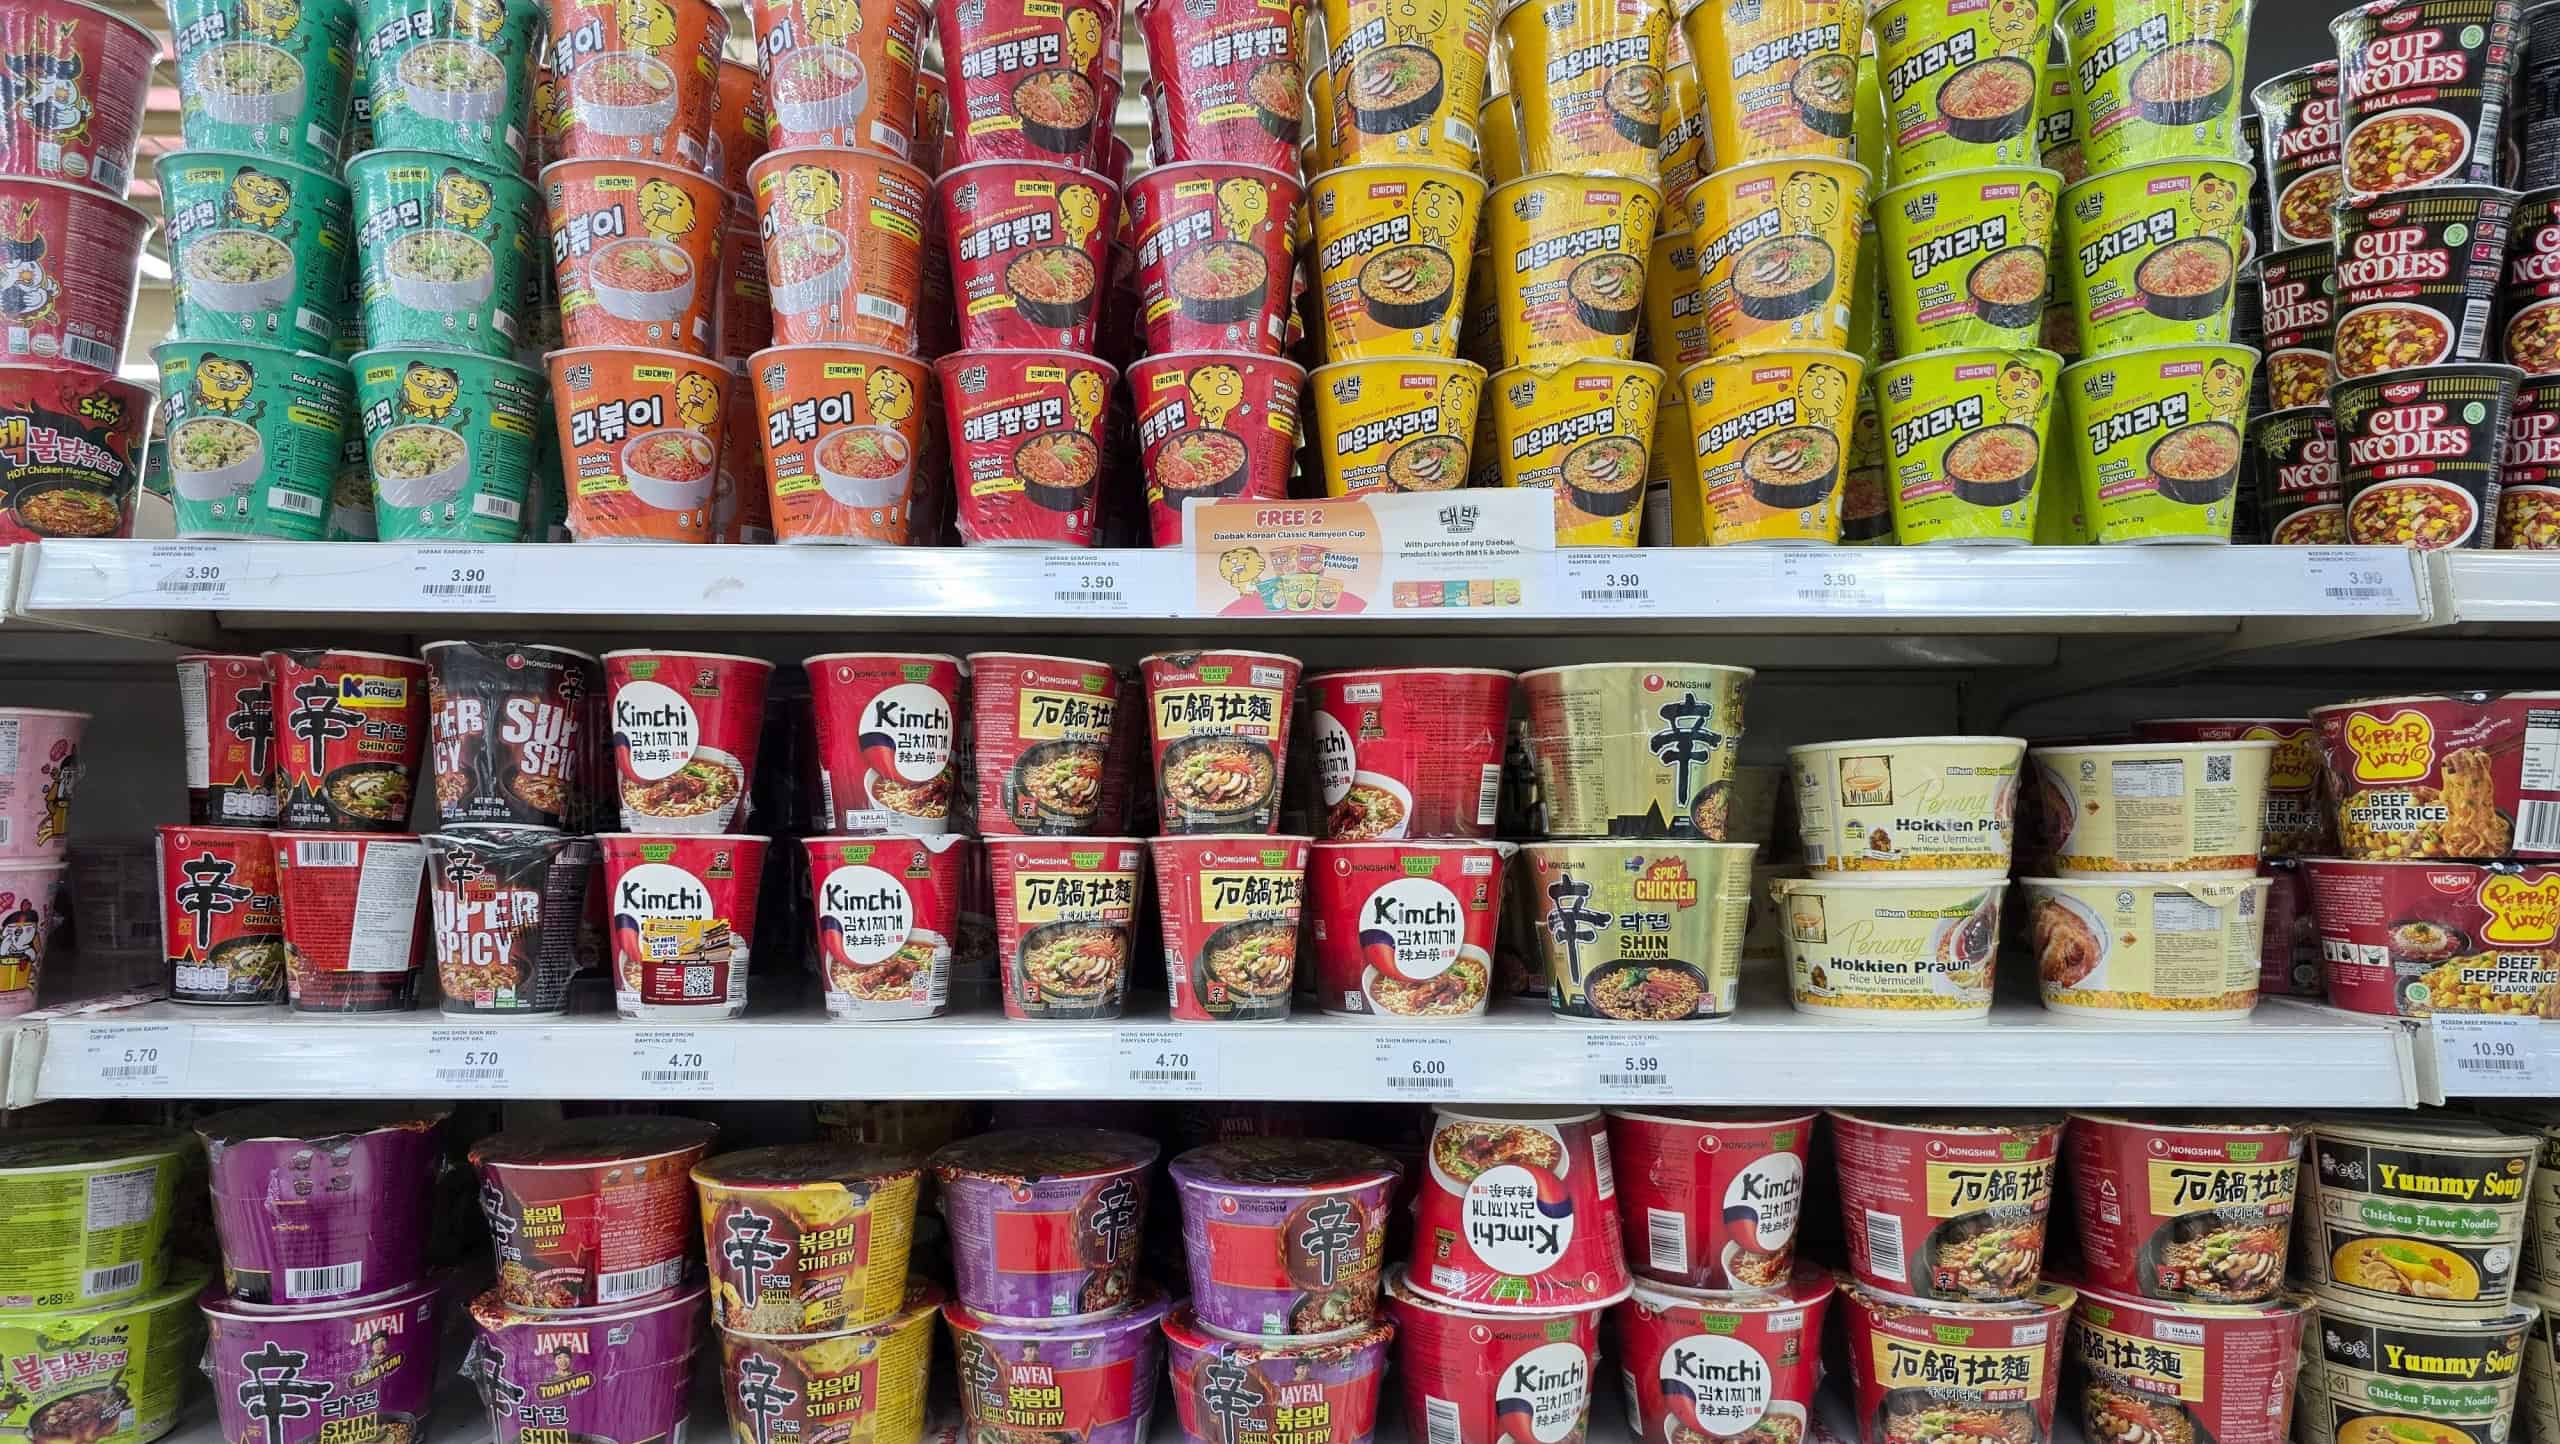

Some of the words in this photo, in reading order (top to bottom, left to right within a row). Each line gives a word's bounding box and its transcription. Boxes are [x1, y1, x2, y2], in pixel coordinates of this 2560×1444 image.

[2382, 8, 2418, 26] NISSIN
[961, 28, 1060, 79] 해물짬뽕면
[2367, 30, 2442, 66] CUP
[1548, 34, 1649, 84] 매운버섯라면
[1887, 29, 1975, 101] 김치라면
[2349, 52, 2464, 95] NOODLES
[966, 94, 1000, 108] Seafood
[1552, 89, 1603, 108] Mushroom
[2364, 94, 2399, 113] MALA
[553, 205, 624, 263] 라볶이
[959, 210, 1053, 261] 해물짬뽕면
[2355, 225, 2425, 260] CUP
[1516, 224, 1620, 273] 매운버섯라면
[1908, 215, 2005, 277] 김치라면
[2337, 249, 2448, 289] NOODLES
[964, 273, 995, 290] Seafood
[1519, 279, 1567, 297] Mushroom
[1917, 283, 1949, 299] Kimchi
[1920, 292, 1956, 309] Flavour
[2384, 384, 2421, 397] NISSIN
[571, 395, 663, 445] 라볶이
[963, 398, 1062, 442] 해물짬뽕면
[1699, 398, 1796, 455] 매운버섯라면
[1891, 396, 1982, 456] 김치라면
[2088, 393, 2188, 455] 김치라면
[2369, 403, 2446, 436] CUP
[1337, 407, 1439, 455] 매운버섯라면
[2350, 426, 2469, 468] NOODLES
[580, 465, 610, 476] Flavour
[969, 456, 1002, 470] Seafood
[1341, 464, 1386, 478] Mushroom
[7, 469, 25, 480] HOT
[28, 466, 63, 475] Chicken
[973, 468, 1005, 480] Flavour
[1348, 476, 1380, 488] Flavour
[1257, 511, 1304, 526] FREE
[1312, 511, 1323, 524] 2
[1440, 505, 1480, 527] 대박
[1214, 532, 1245, 540] Daebak
[1309, 531, 1347, 539] Ramyeon
[1325, 554, 1359, 563] RANDOM
[185, 567, 219, 579] 3.90
[451, 569, 485, 582] 3.90
[1081, 576, 1114, 588] 3.90
[1607, 574, 1639, 587] 3.90
[1823, 574, 1857, 586] 3.90
[2350, 572, 2383, 585] 3.90
[526, 659, 564, 671] NONGSHIM
[364, 687, 402, 697] KOREA
[1666, 680, 1712, 690] NONGSHIM
[616, 700, 687, 728] Kimchi
[1161, 693, 1272, 724] 石鍋拉麵
[290, 677, 366, 776] 辛
[359, 741, 385, 750] SHIN
[631, 732, 688, 747] 김치찌개
[1650, 692, 1723, 807] 辛
[2371, 795, 2409, 806] BEEF
[2406, 808, 2446, 820] RICE
[1653, 865, 1683, 880] SPICY
[2433, 875, 2471, 887] NISSIN
[622, 882, 701, 911] Kimchi
[826, 884, 902, 912] Kimchi
[1027, 879, 1132, 910] 石鍋拉麵
[1636, 881, 1696, 901] CHICKEN
[176, 852, 251, 949] 辛
[1374, 897, 1456, 925] Kimchi
[1875, 910, 1904, 918] Bihun
[1908, 910, 1938, 918] Udang
[844, 916, 904, 931] 김치찌개
[1547, 873, 1612, 986] 辛
[1620, 911, 1671, 931] 라면
[1620, 937, 1668, 950] SHIN
[1620, 950, 1668, 959] RAMYUN
[2499, 957, 2538, 969] BEEF
[1830, 958, 1907, 972] Hokkien
[1914, 961, 1969, 972] Prawn
[1850, 974, 1870, 983] Rice
[1874, 976, 1923, 985] Vermicelli
[2463, 969, 2528, 983] PEPPER
[2532, 971, 2557, 983] RICE
[2493, 985, 2537, 994] FLAVOUR
[124, 1048, 157, 1063] 5.70
[2472, 1042, 2515, 1056] 10.90
[465, 1052, 498, 1065] 5.70
[669, 1054, 702, 1067] 4.70
[1156, 1054, 1189, 1067] 4.70
[1412, 1061, 1445, 1074] 6.00
[1625, 1058, 1658, 1071] 5.99
[2170, 1146, 2222, 1157] NONGSHIM
[2379, 1164, 2481, 1199] Yummy
[2483, 1173, 2522, 1198] Soup
[522, 1206, 563, 1224] 볶음면
[1092, 1178, 1137, 1264] 辛
[2361, 1207, 2413, 1225] Chicken
[2416, 1216, 2457, 1229] Flavor
[2461, 1219, 2498, 1230] Noodles
[521, 1224, 544, 1238] STIR
[545, 1223, 566, 1238] FRY
[799, 1224, 854, 1253] 볶음면
[1473, 1223, 1559, 1254] Kimchi
[724, 1207, 790, 1309] 辛
[798, 1253, 829, 1272] STIR
[831, 1250, 855, 1267] FRY
[535, 1330, 590, 1356] JAYFAI
[1674, 1349, 1761, 1383] Kimchi
[1887, 1343, 2031, 1386] 石鍋拉麵
[1010, 1366, 1054, 1386] JAYFAI
[1514, 1360, 1585, 1394] Kimchi
[1008, 1387, 1061, 1409] 볶음면
[1698, 1384, 1761, 1402] 김치찌개
[319, 1390, 378, 1417] 라면
[322, 1413, 377, 1436] SHIN
